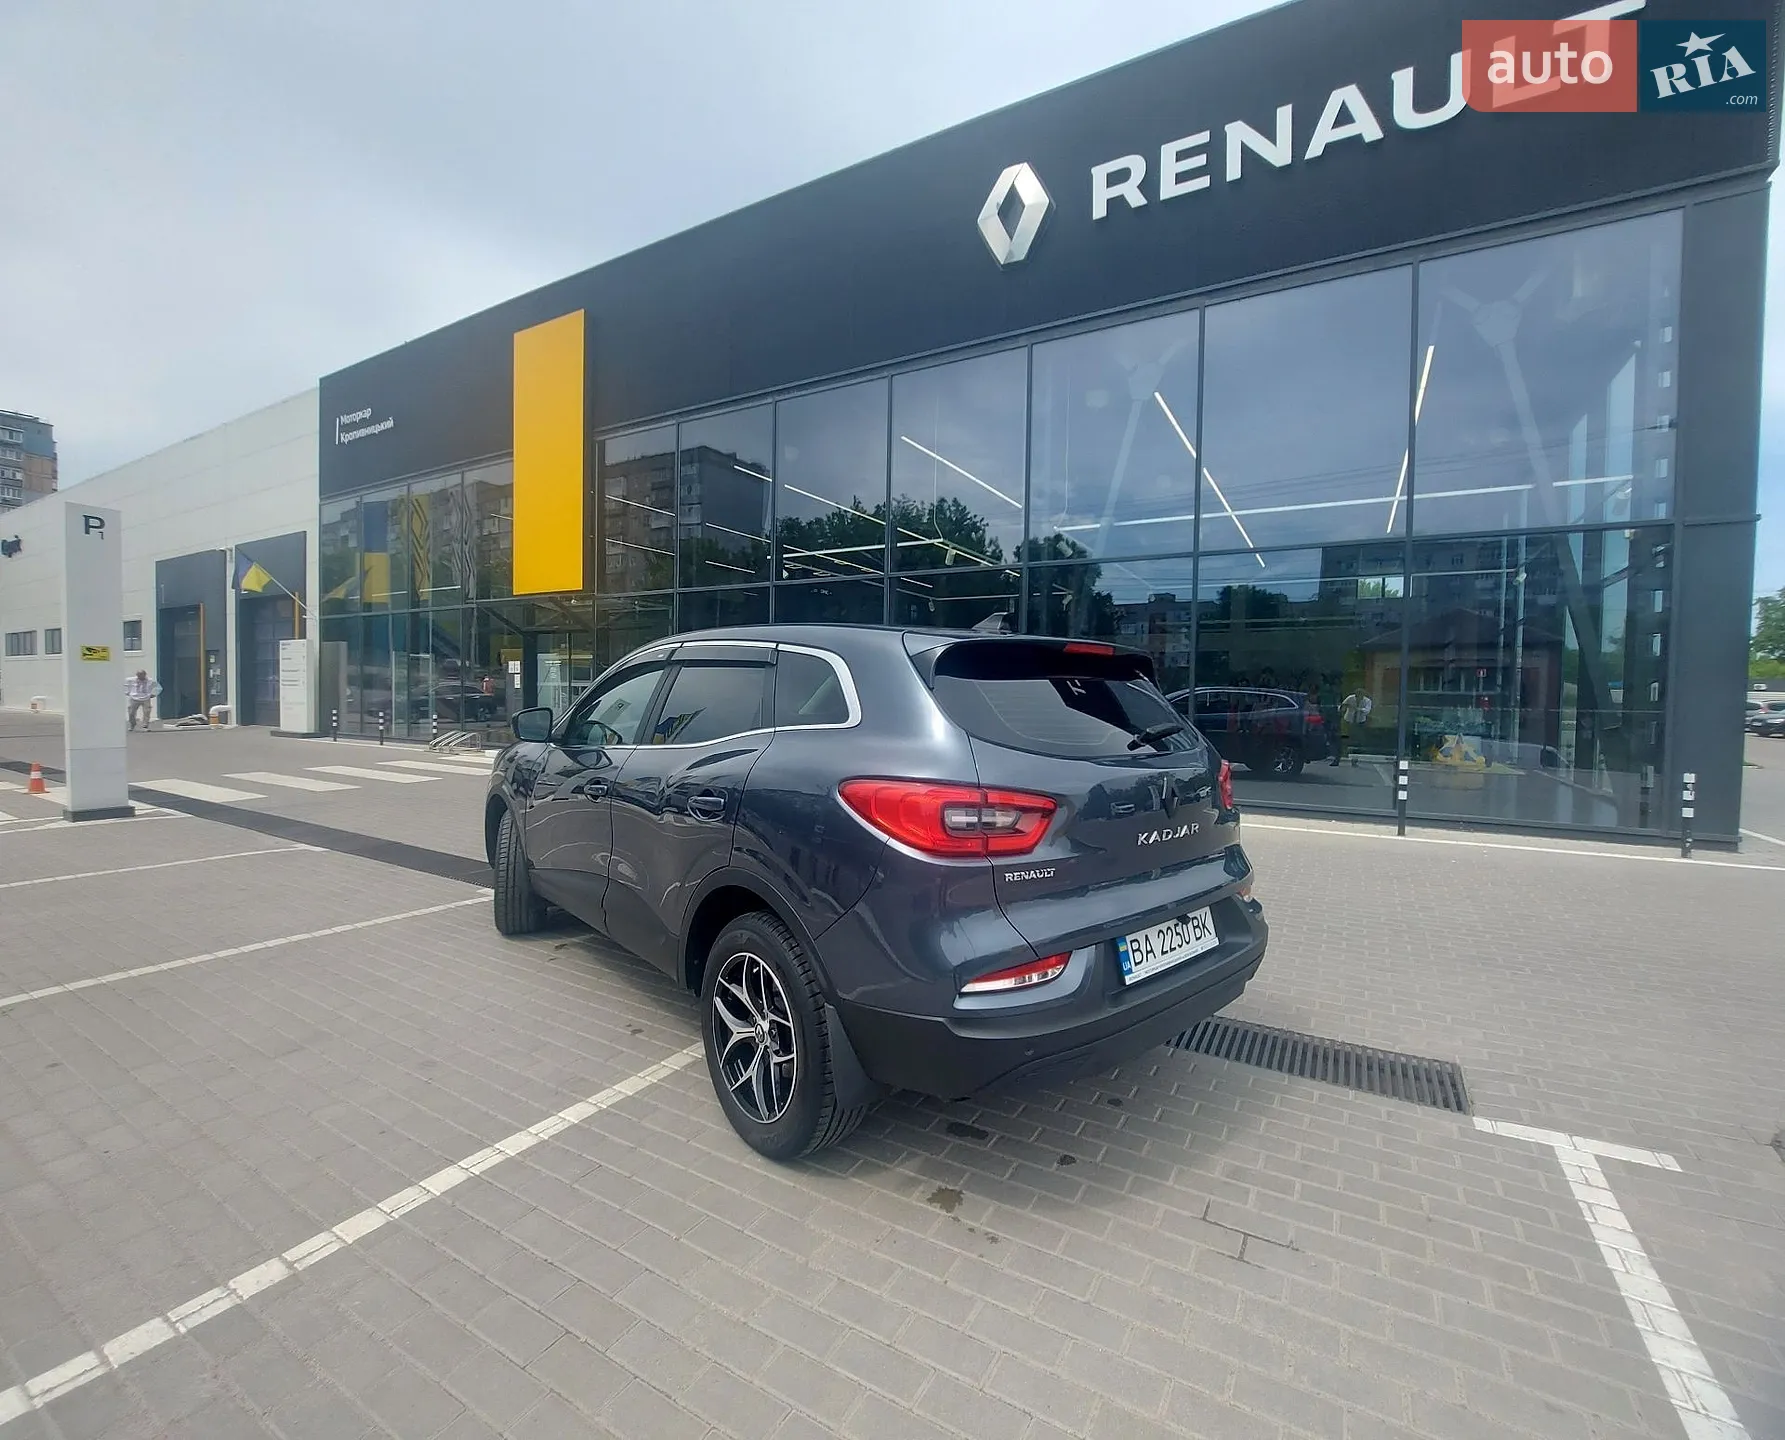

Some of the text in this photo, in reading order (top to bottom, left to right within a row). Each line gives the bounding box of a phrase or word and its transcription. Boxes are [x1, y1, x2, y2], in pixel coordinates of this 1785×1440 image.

[1091, 0, 1646, 220] RENAULT
[1137, 822, 1199, 846] KADJAR
[1004, 867, 1056, 882] RENAULT
[1129, 934, 1157, 967] BA
[1157, 921, 1191, 956] 2250
[1191, 911, 1212, 941] BK
[1122, 961, 1132, 972] UA
